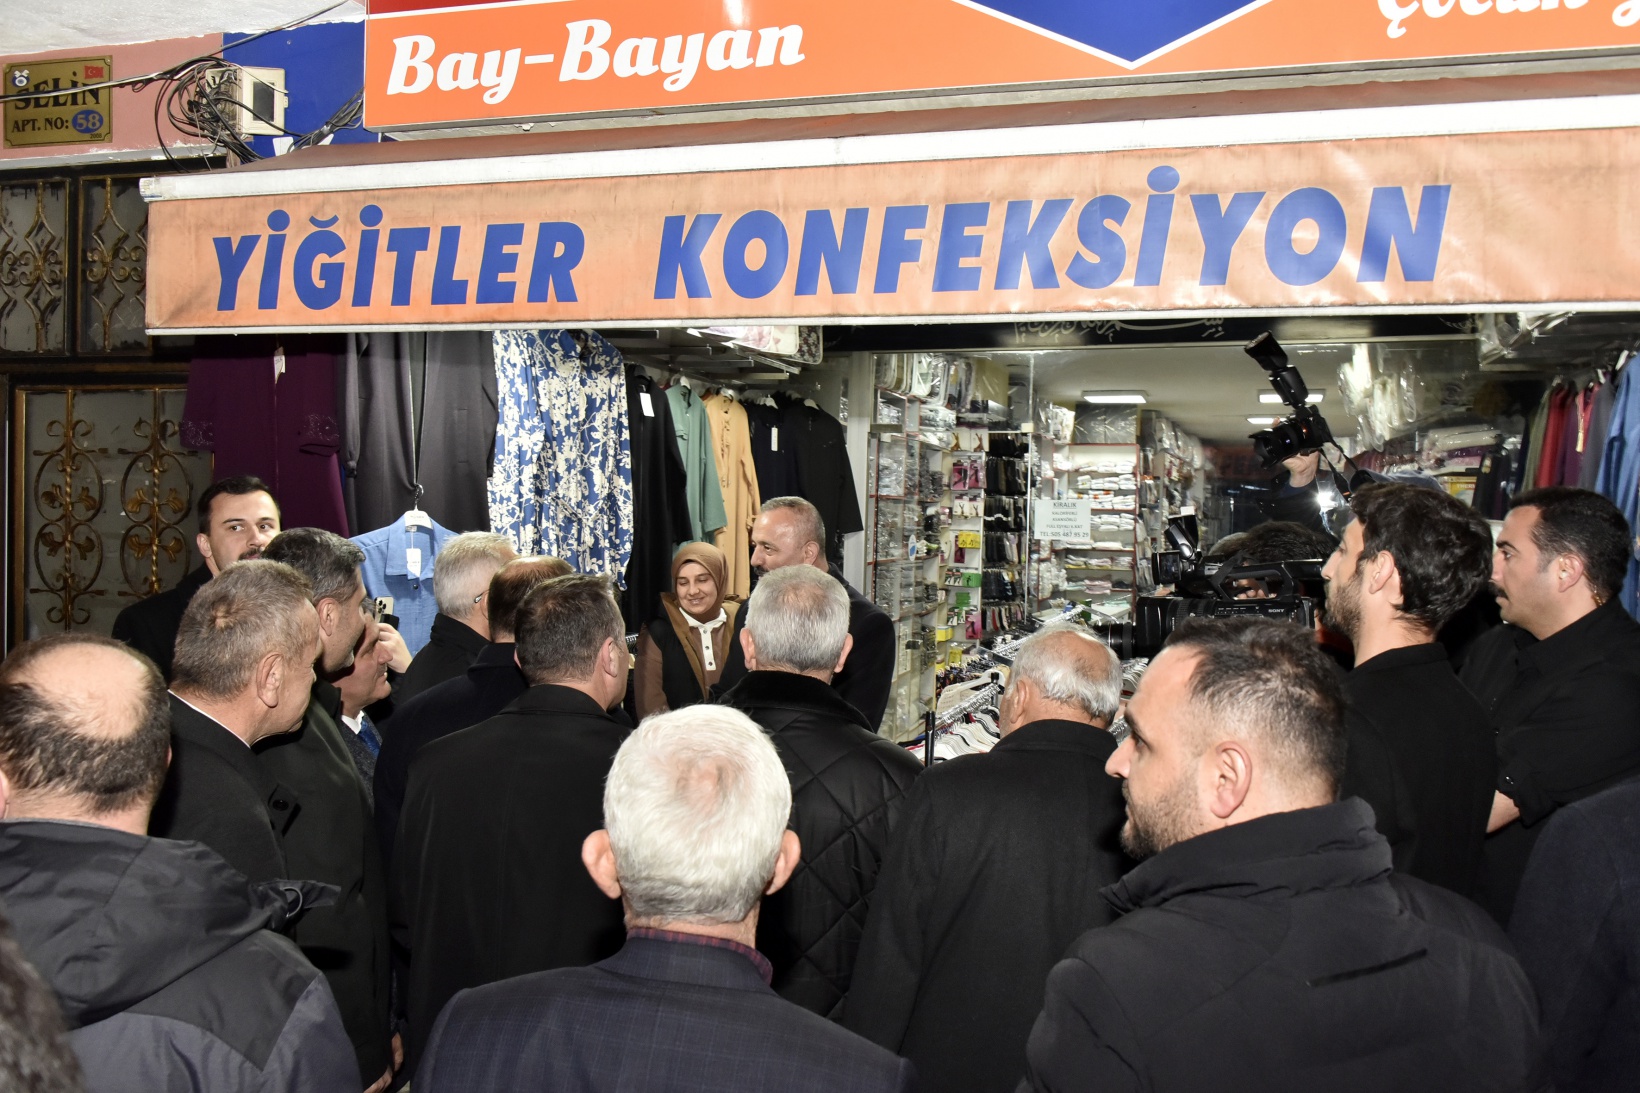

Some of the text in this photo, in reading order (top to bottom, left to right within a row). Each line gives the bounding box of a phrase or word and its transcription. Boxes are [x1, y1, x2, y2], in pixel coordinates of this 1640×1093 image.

[14, 71, 100, 110] SELİN
[387, 19, 806, 105] Bay-Bayan
[12, 113, 100, 133] APT. NO: 58
[214, 166, 1450, 311] YİĞİTLER KONFEKSİYON
